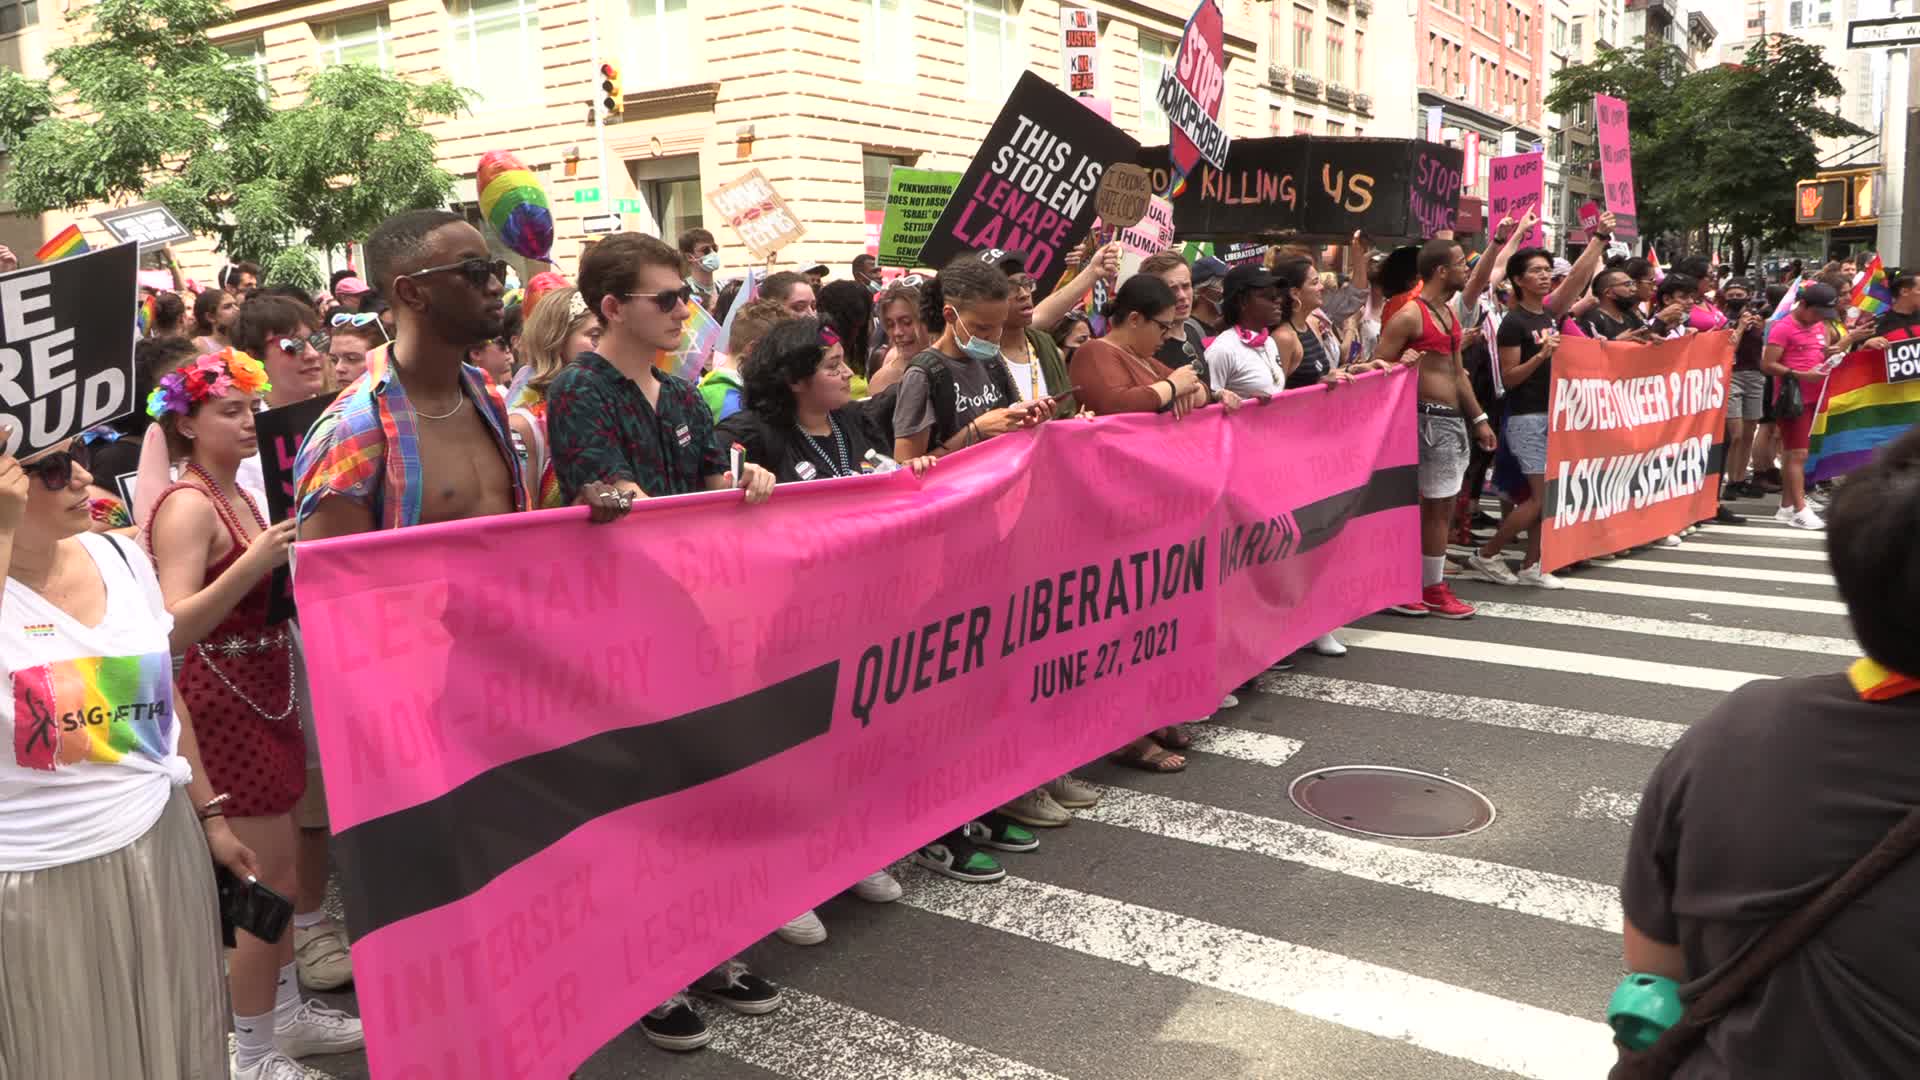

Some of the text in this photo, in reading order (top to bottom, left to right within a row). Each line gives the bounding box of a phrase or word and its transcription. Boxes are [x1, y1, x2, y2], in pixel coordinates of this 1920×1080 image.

[1180, 22, 1223, 116] STOP
[1009, 114, 1072, 172] THIS
[1070, 155, 1103, 192] IS
[1156, 63, 1232, 169] HOMOPHOBIA
[888, 195, 909, 206] DOES
[909, 196, 926, 206] NOT
[897, 182, 953, 195] PINKWASHING
[973, 171, 1072, 248] LENAPE
[991, 145, 1088, 221] STOLEN
[1201, 164, 1297, 211] KILLING
[1322, 162, 1376, 213] US
[1416, 152, 1460, 203] STOP
[1493, 161, 1538, 181] NO COPS
[1493, 197, 1507, 214] NO
[952, 199, 1055, 280] LAND
[1144, 205, 1167, 226] UAL
[1553, 453, 1643, 530] ASYLUM
[851, 513, 1295, 728] QUEER LIBERATION MARCH
[1029, 617, 1180, 704] JUNE 27, 2021
[379, 862, 600, 1039] INTERSEX
[391, 968, 586, 1080] UEER
[618, 853, 771, 986] LESBIAN
